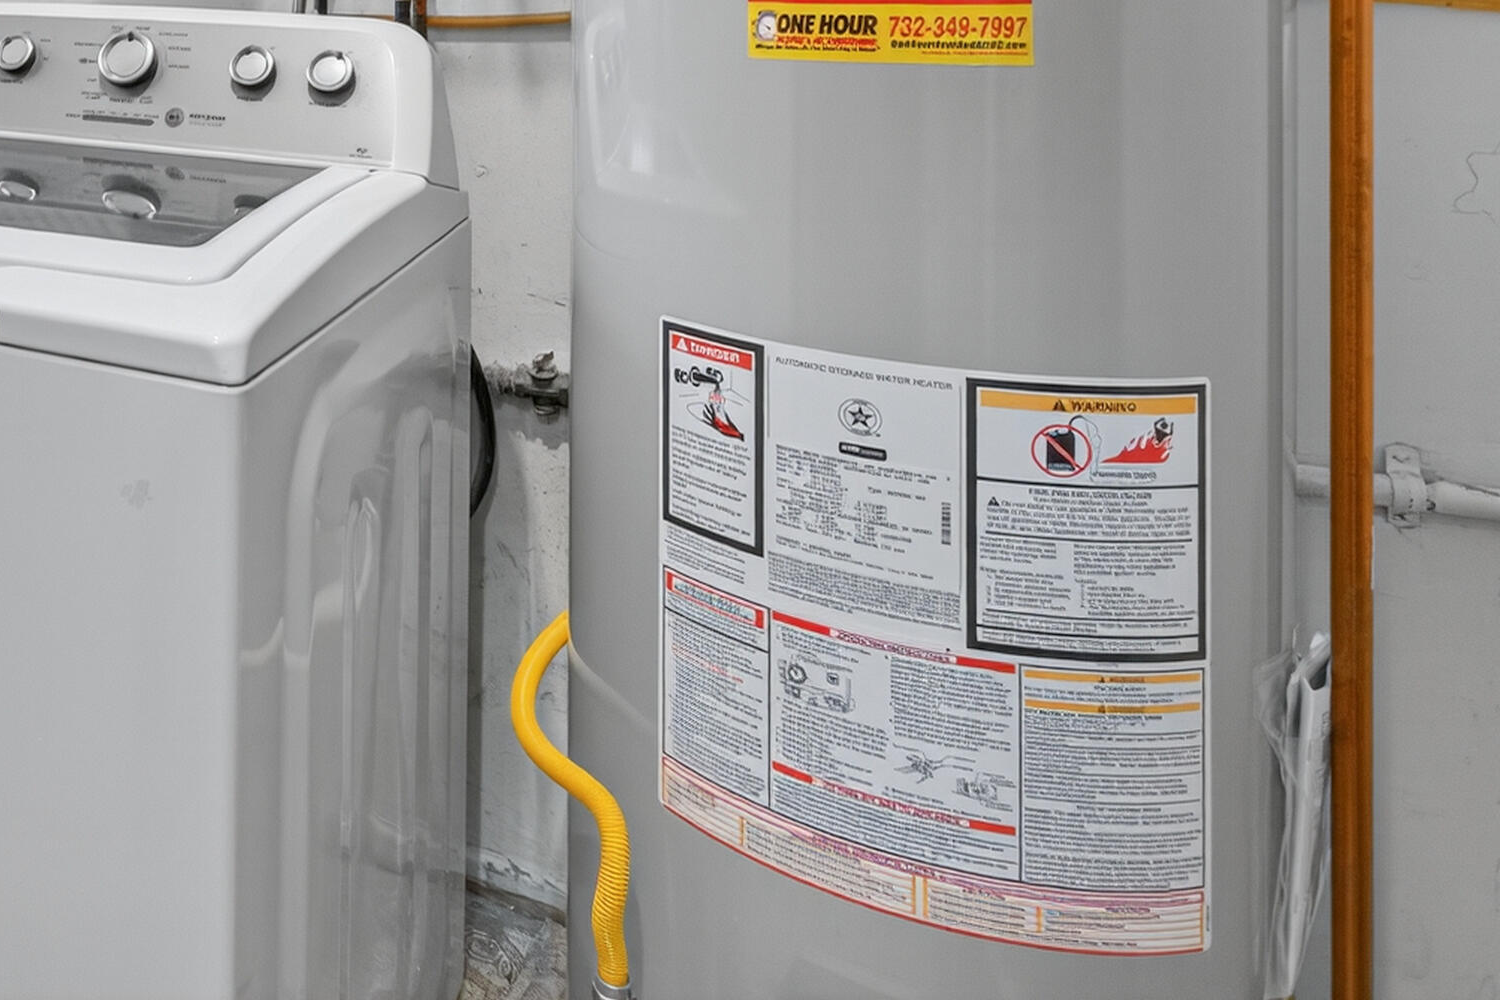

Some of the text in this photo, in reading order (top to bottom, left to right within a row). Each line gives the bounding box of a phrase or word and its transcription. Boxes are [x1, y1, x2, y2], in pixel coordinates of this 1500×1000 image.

[777, 13, 878, 36] ONE HOUR
[888, 15, 1028, 39] 732-349-7997
